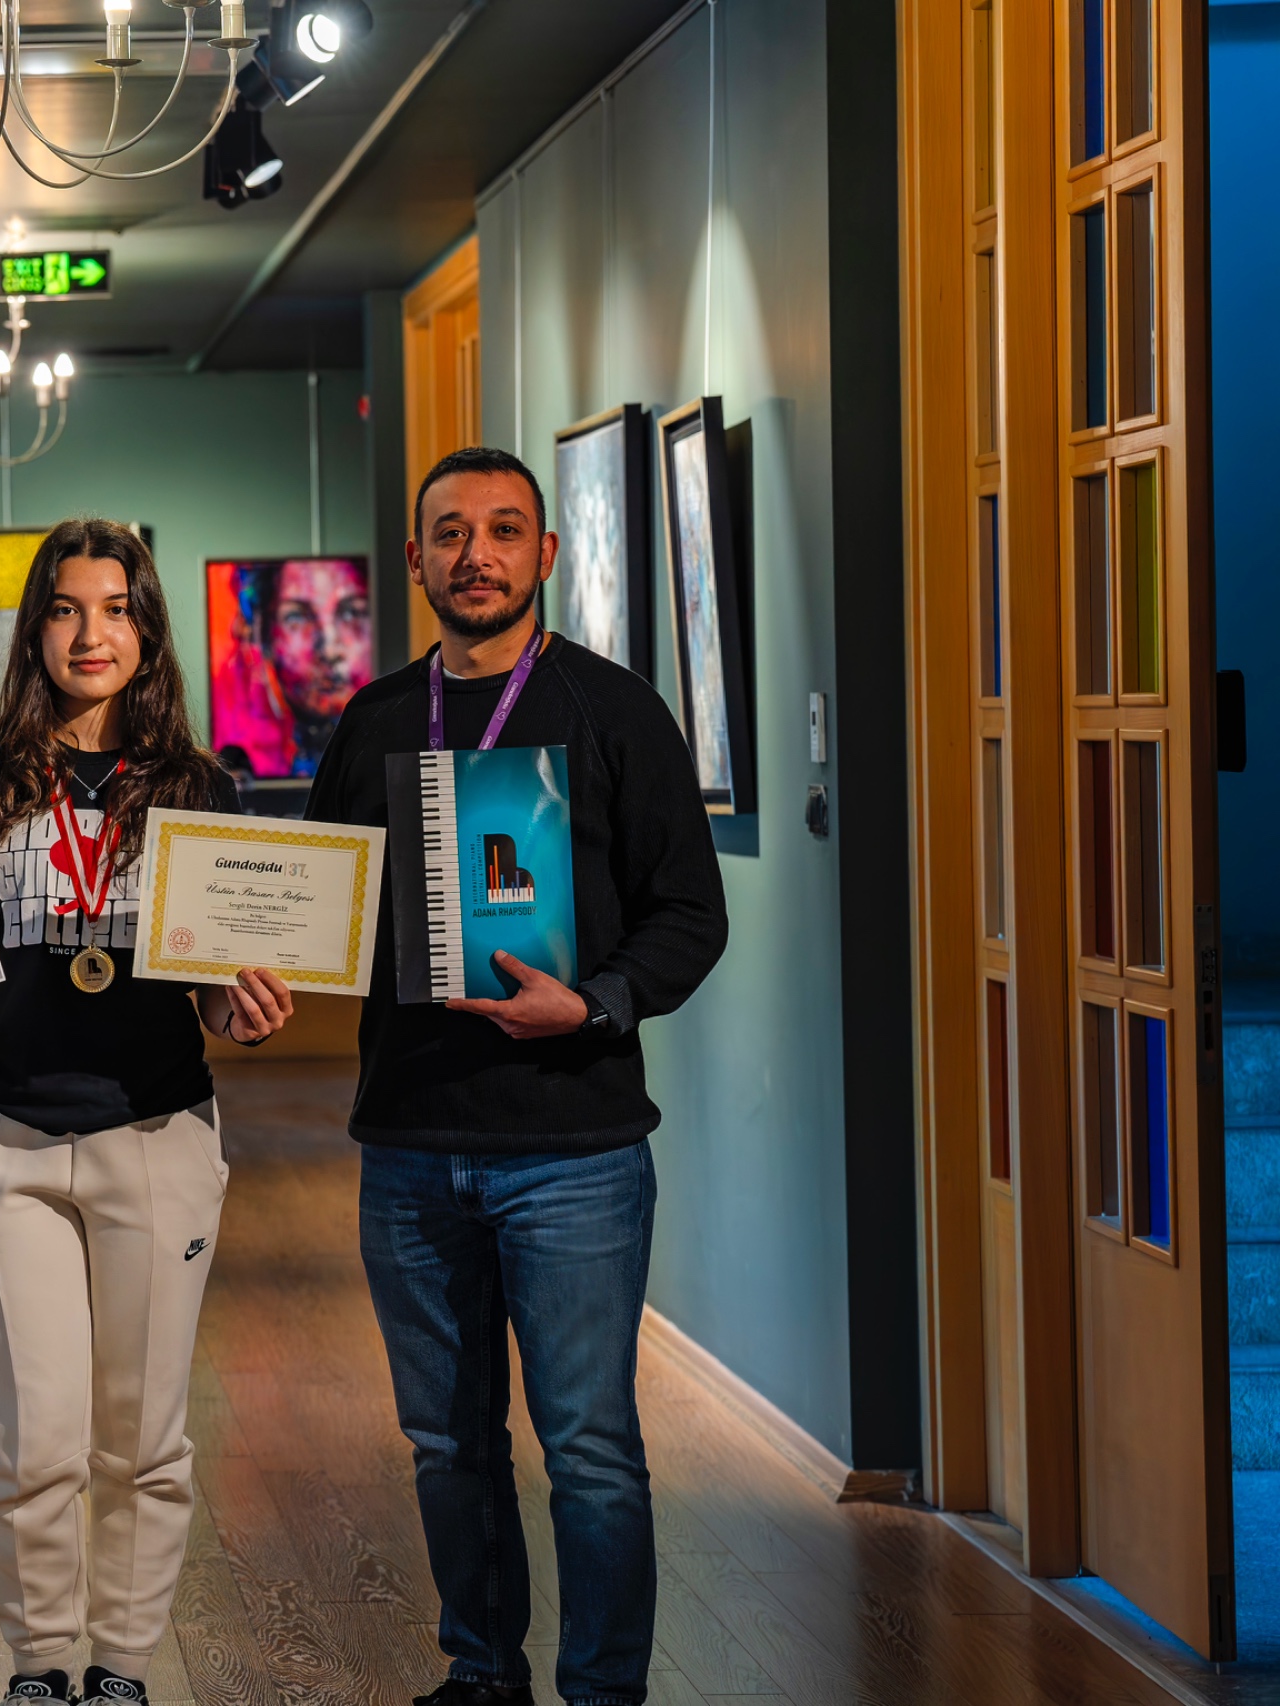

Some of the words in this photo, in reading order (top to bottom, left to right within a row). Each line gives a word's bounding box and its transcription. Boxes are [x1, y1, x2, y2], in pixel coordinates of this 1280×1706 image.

[215, 857, 282, 874] Gundoğdu
[205, 882, 235, 895] Üstün
[277, 890, 315, 904] Belgesi
[472, 907, 497, 918] ADANA
[498, 905, 537, 917] RHAPSODY
[49, 946, 76, 956] SINCE
